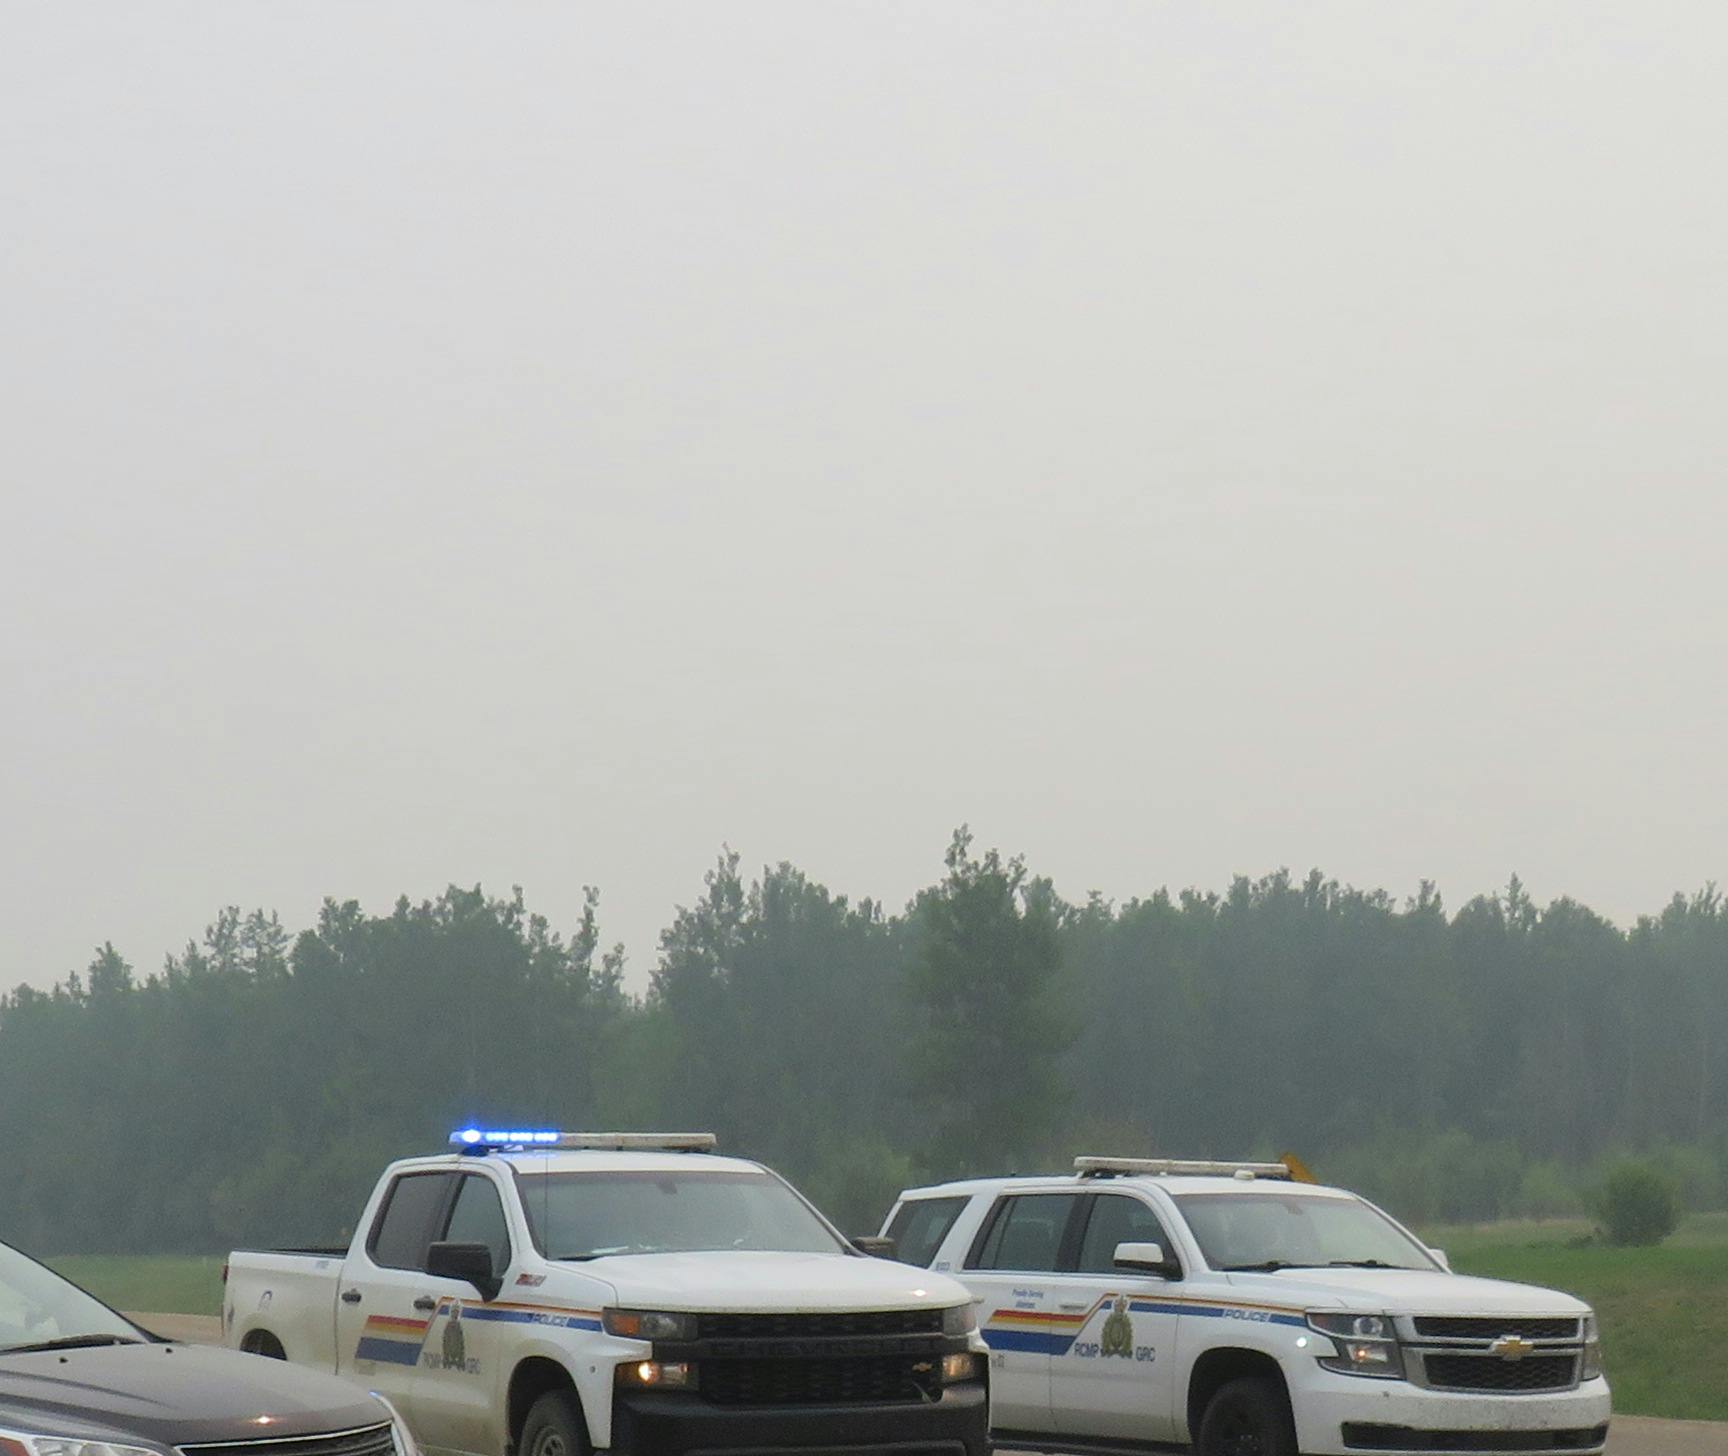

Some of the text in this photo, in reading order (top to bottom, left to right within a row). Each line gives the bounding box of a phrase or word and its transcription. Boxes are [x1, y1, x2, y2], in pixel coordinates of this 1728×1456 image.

[532, 1312, 568, 1328] POLICE
[1223, 1309, 1270, 1322] POLICE
[1074, 1342, 1156, 1361] RCMP GRC
